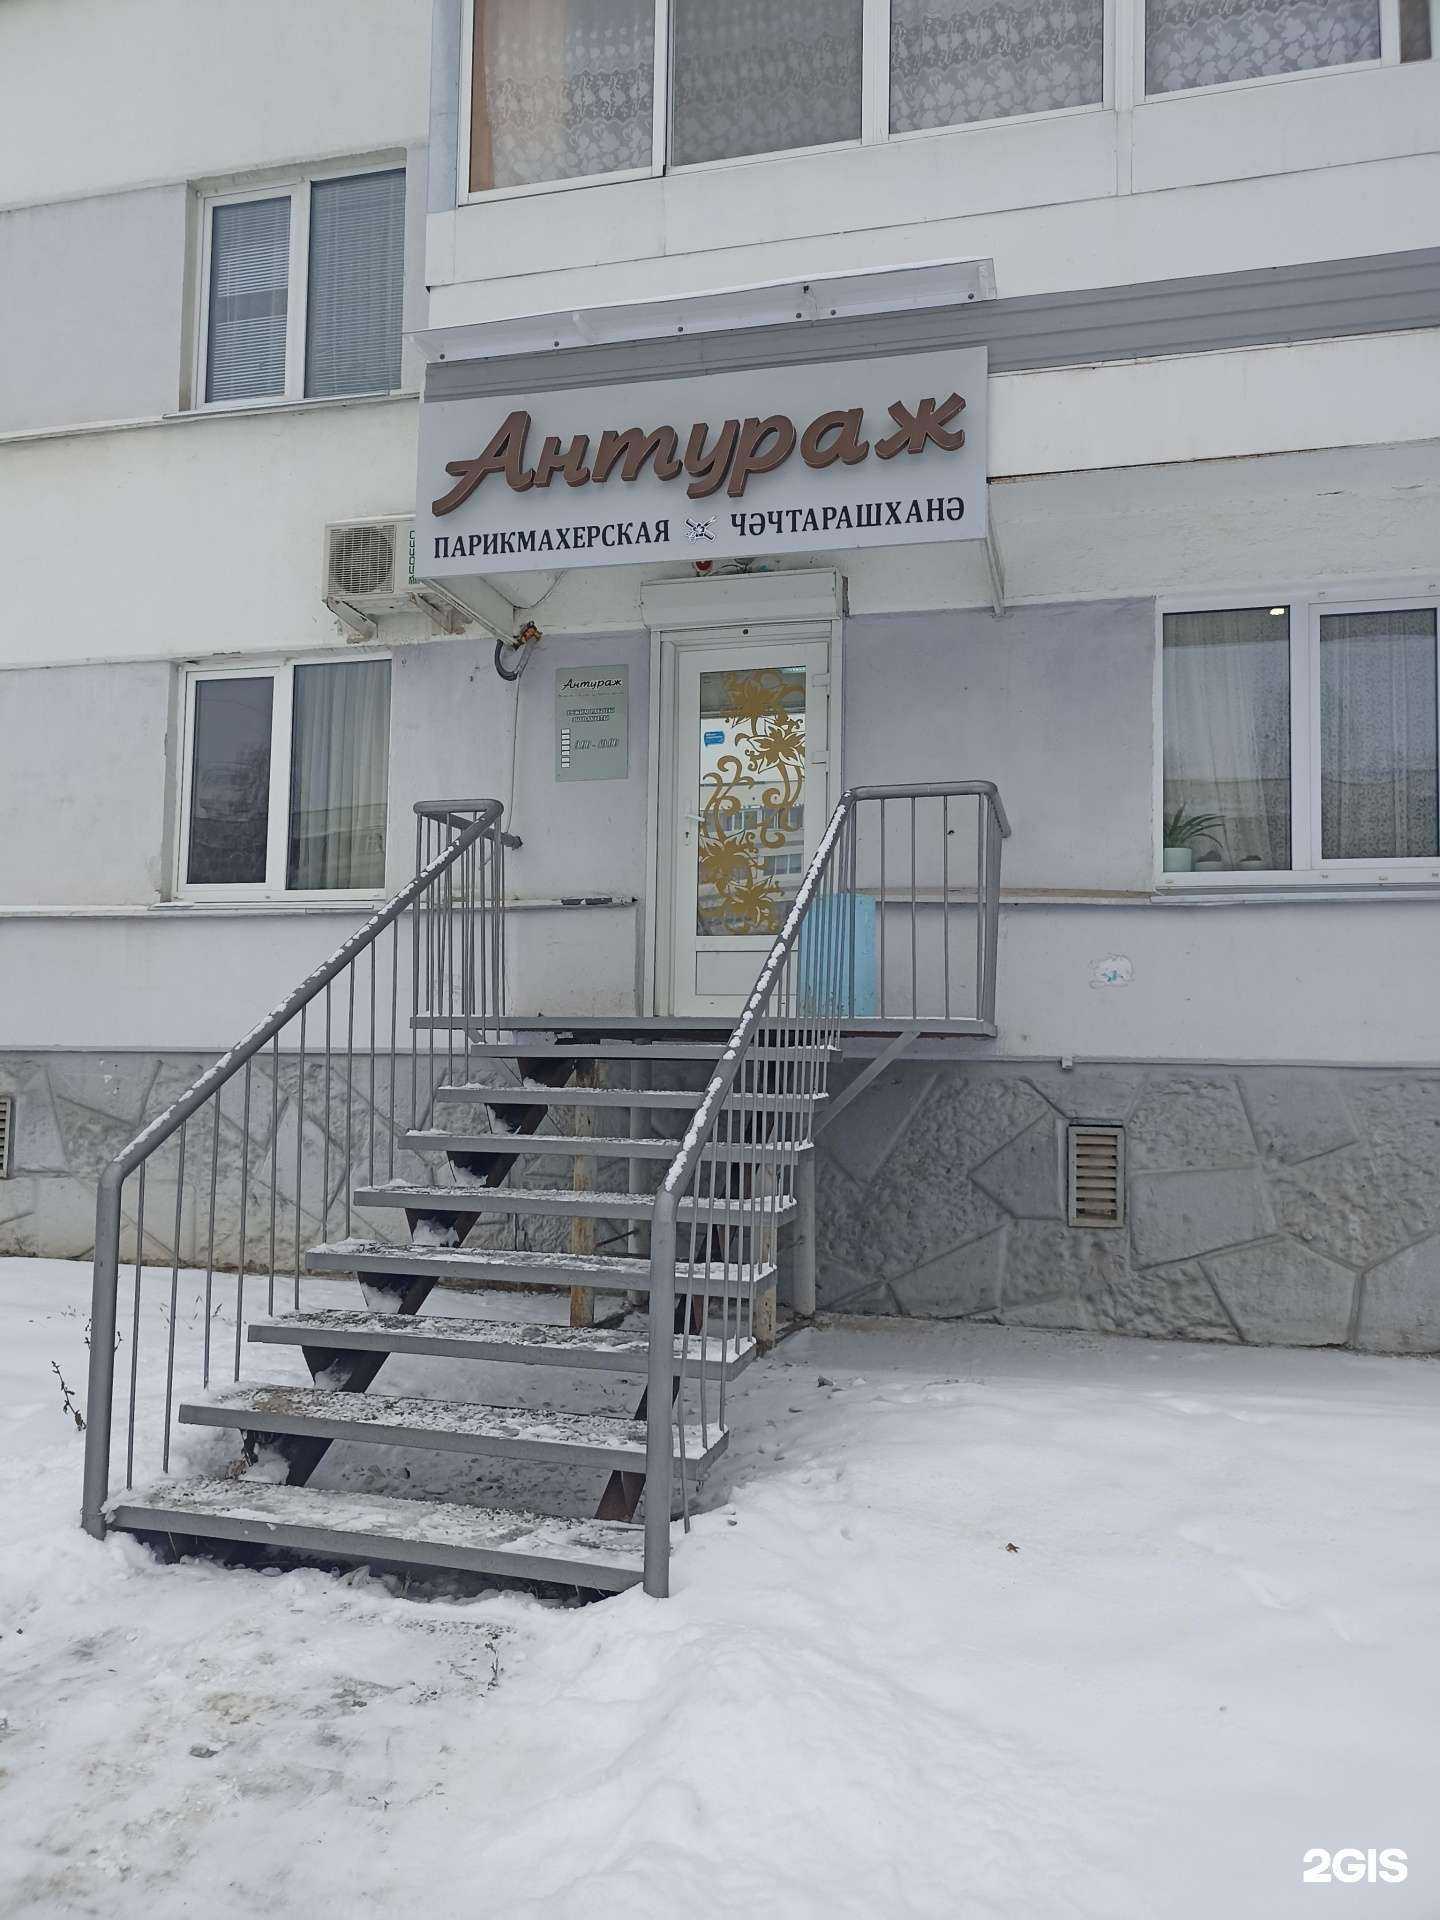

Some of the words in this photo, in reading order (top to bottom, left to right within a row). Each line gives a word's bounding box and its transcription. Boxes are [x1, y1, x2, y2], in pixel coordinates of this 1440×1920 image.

[432, 392, 967, 517] Антураж
[434, 519, 671, 559] ПАРИКМАХЕРСКАЯ
[730, 496, 966, 538] ЧӘЧТАРАШХАНӘ
[561, 678, 623, 691] Антураж
